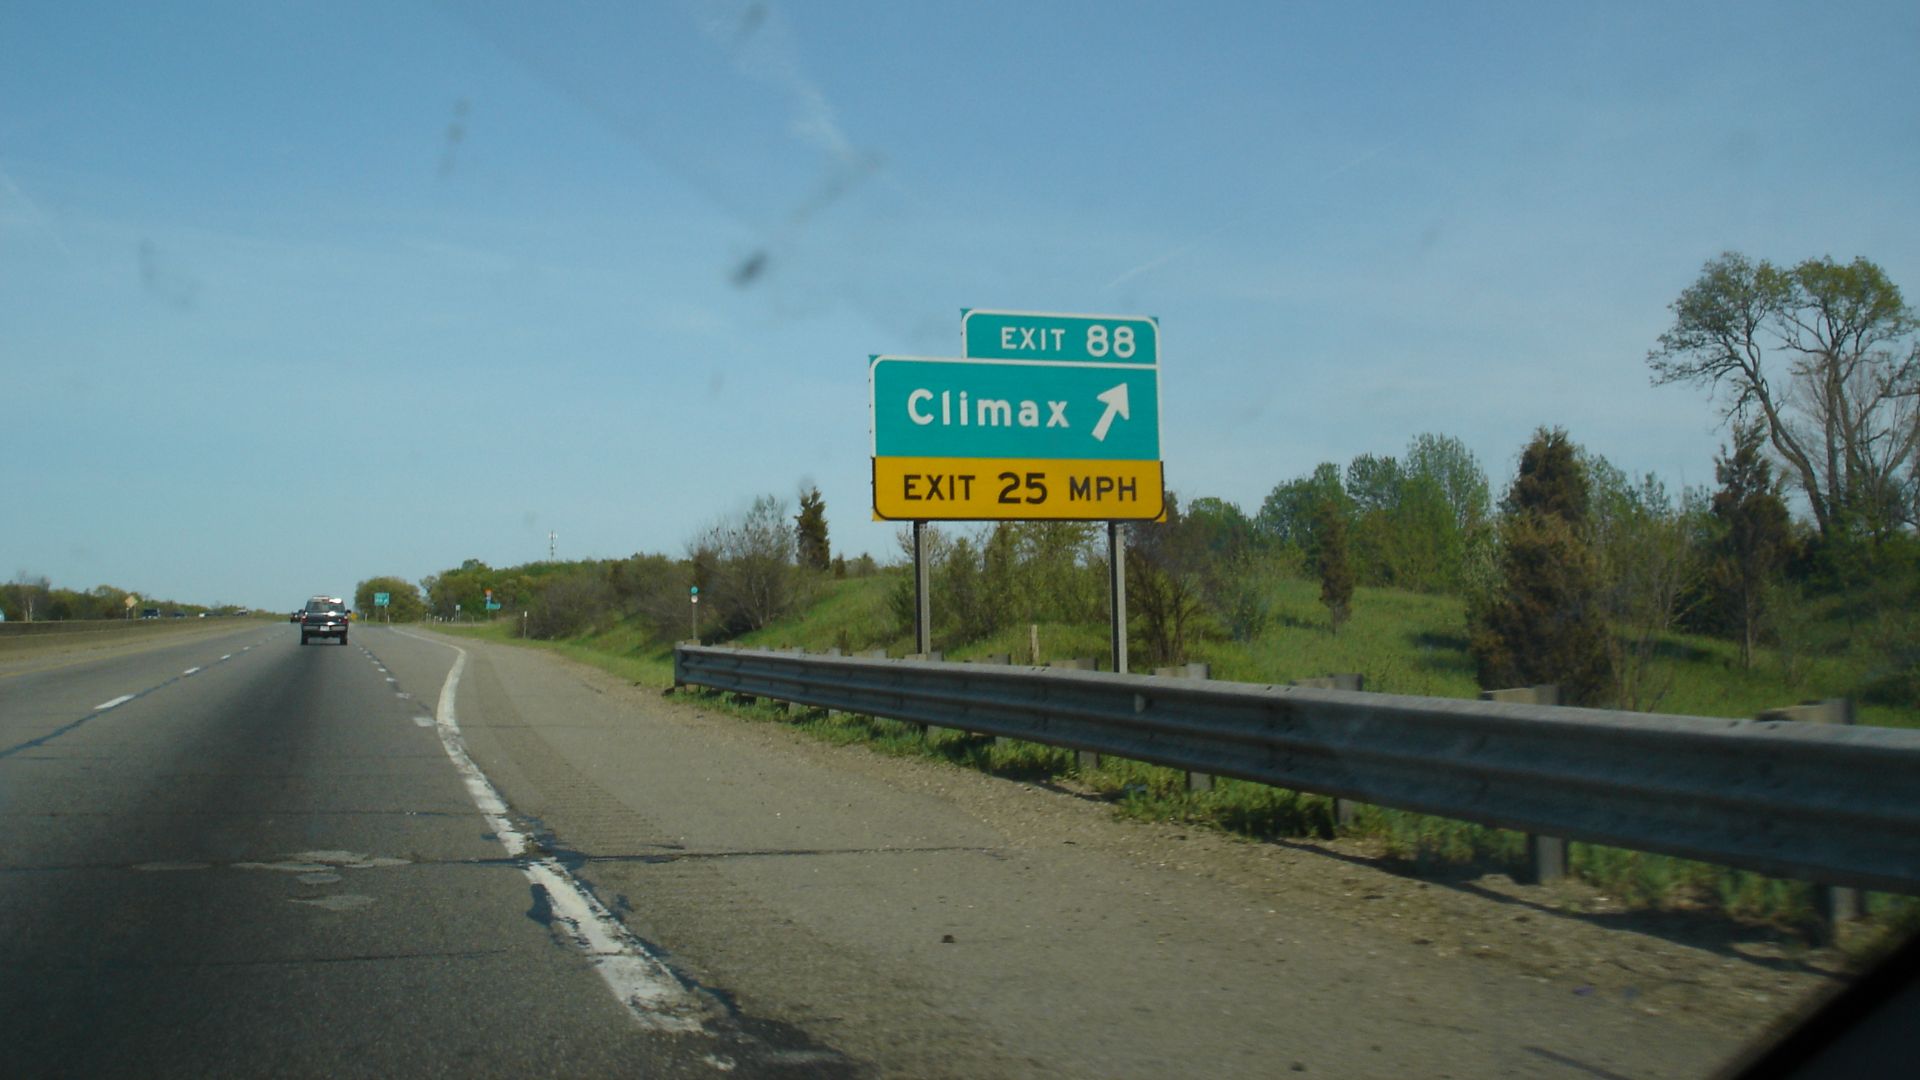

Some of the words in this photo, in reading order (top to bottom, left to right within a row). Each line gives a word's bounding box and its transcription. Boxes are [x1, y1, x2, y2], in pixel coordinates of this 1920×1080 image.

[1001, 326, 1065, 351] EXIT
[1086, 325, 1136, 358] 88
[907, 388, 1070, 428] Climax
[903, 474, 976, 501] EXIT
[997, 471, 1049, 505] 25
[1069, 475, 1138, 502] MPH
